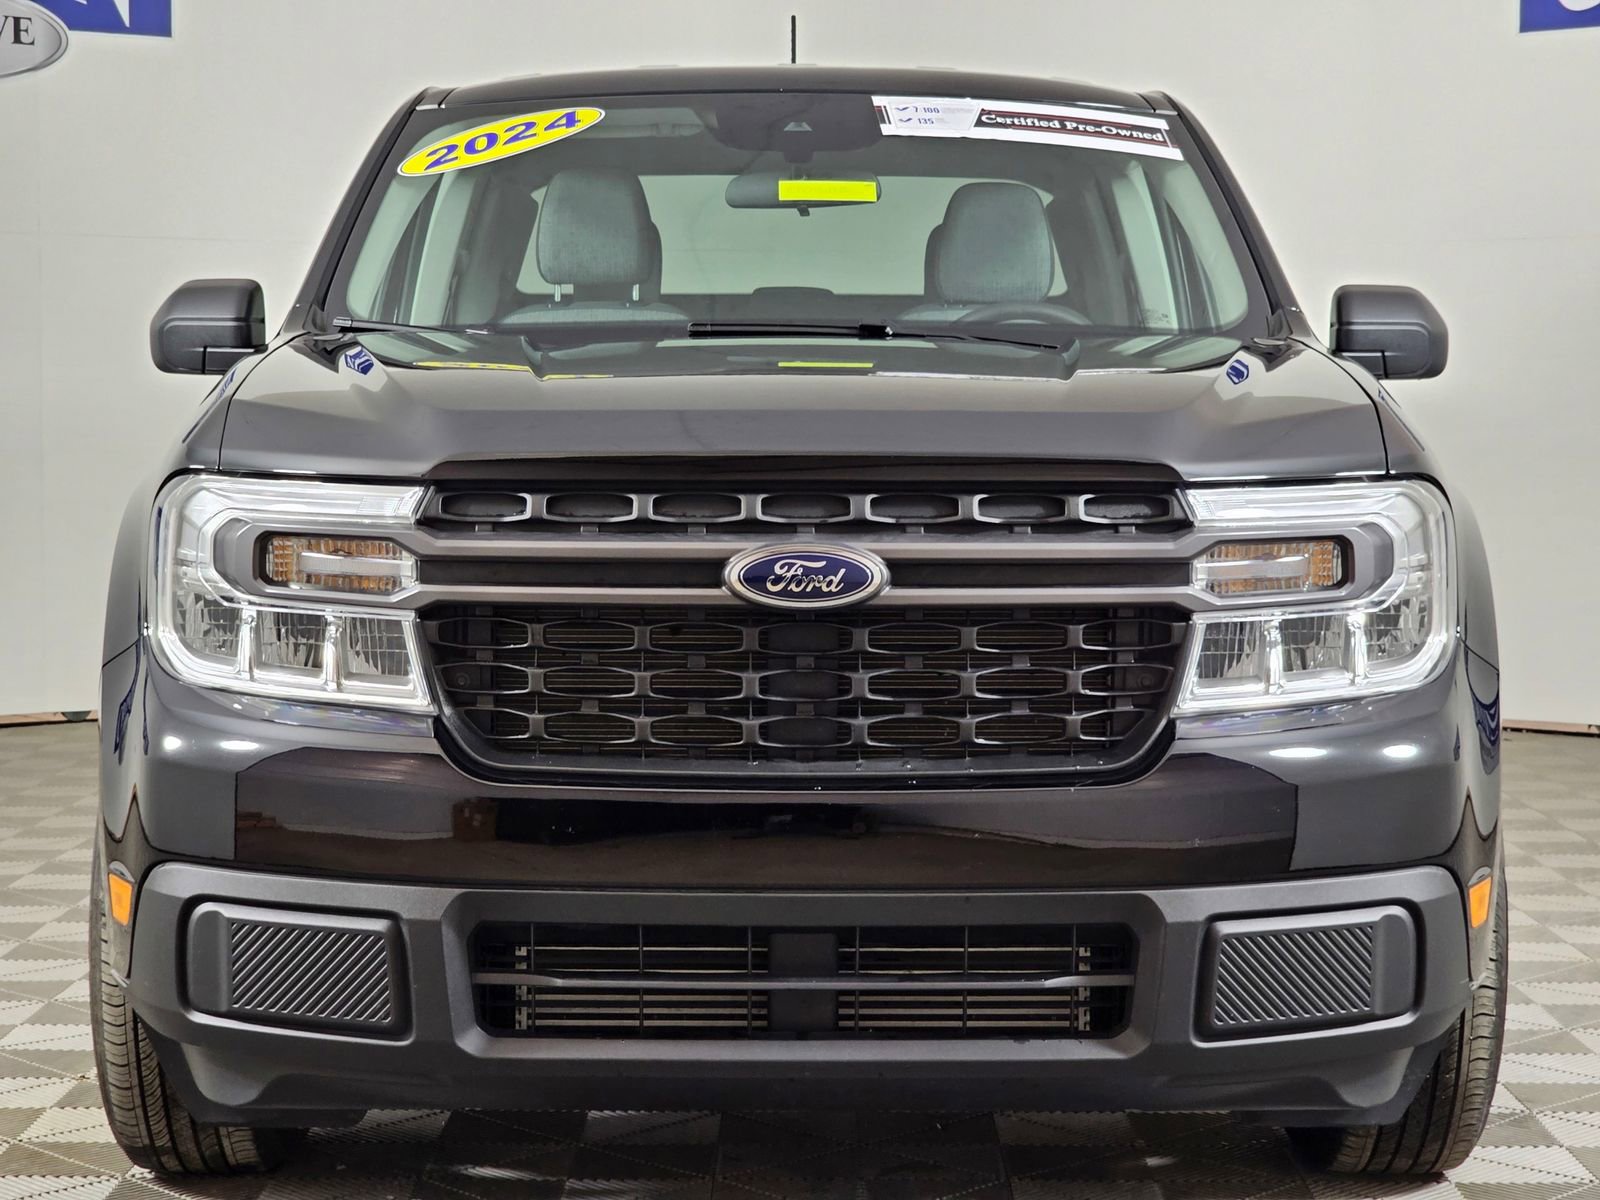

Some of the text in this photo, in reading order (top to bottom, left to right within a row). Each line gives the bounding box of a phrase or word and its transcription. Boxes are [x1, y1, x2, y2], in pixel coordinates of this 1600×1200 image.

[423, 110, 582, 171] 2024
[980, 114, 1165, 142] Certified Pre-Owned
[766, 559, 847, 592] Ford
